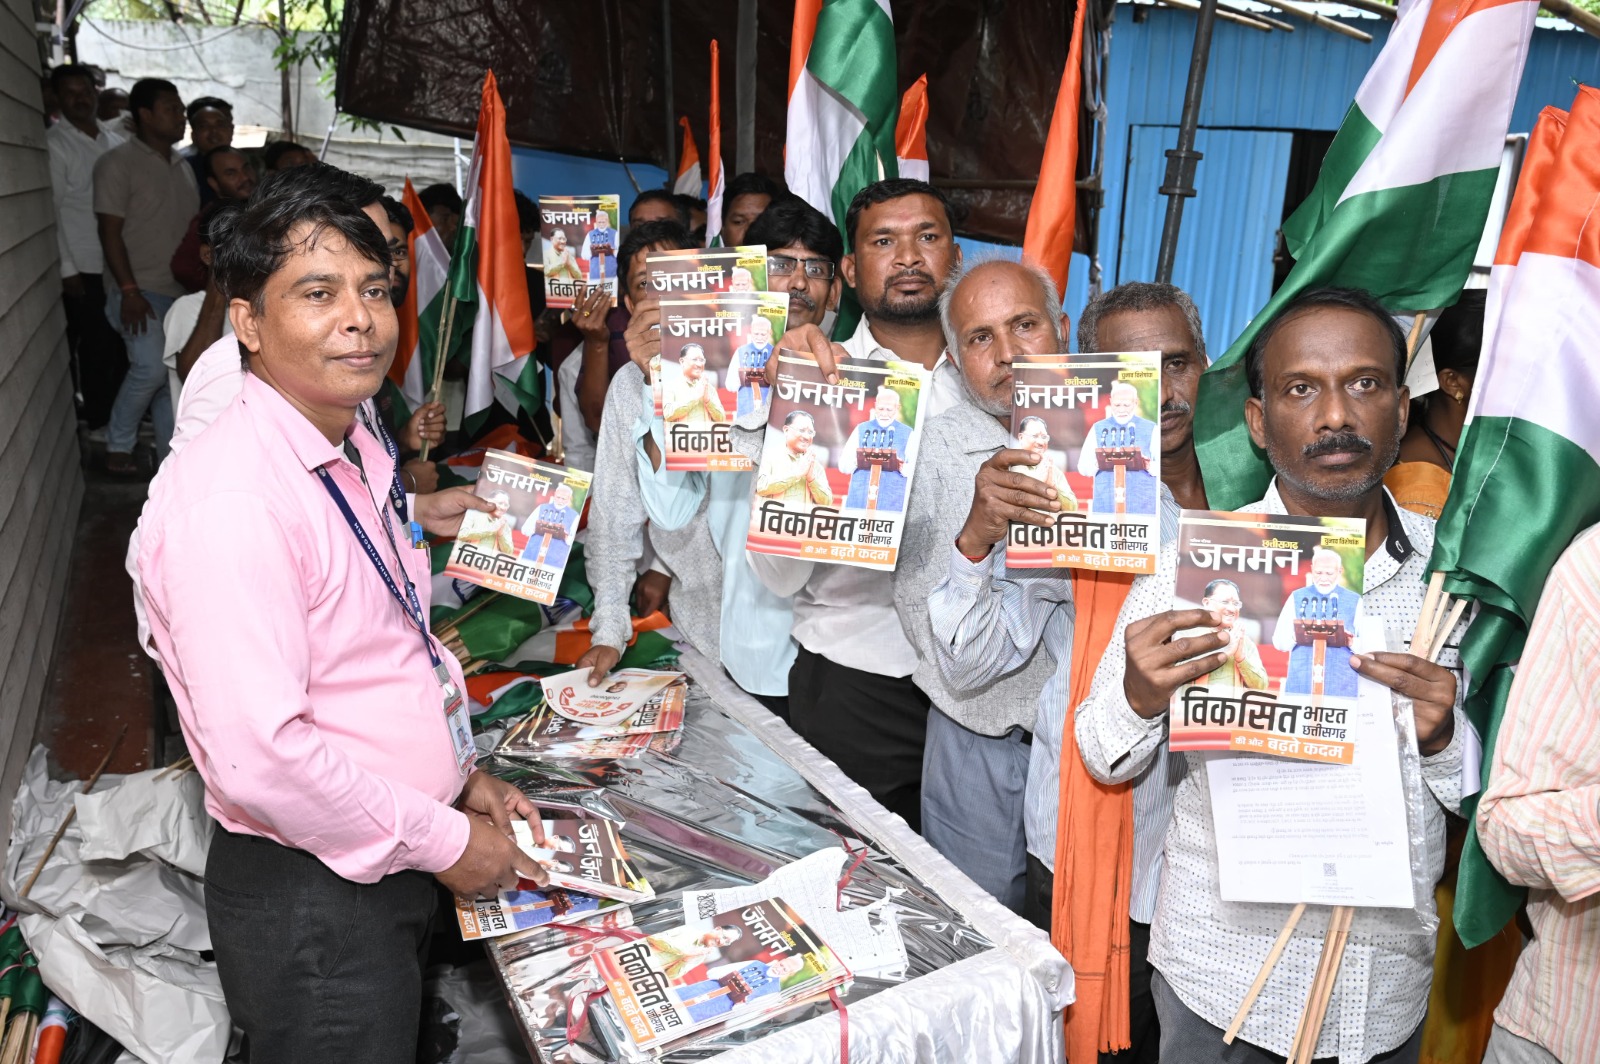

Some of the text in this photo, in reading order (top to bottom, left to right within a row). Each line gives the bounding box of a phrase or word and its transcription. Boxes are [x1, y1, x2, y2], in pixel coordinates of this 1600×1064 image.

[542, 211, 592, 225] जनमन
[652, 270, 725, 291] जनमन
[668, 317, 744, 337] जनमन
[777, 377, 869, 411] जनमन
[1015, 385, 1102, 409] जनमन
[670, 423, 733, 453] विकसि
[486, 467, 552, 496] जनमन
[759, 500, 894, 541] विकसित भारत
[1110, 523, 1148, 538] भारत
[858, 533, 892, 547] छत्तीसगढ़
[1110, 539, 1148, 553] छत्तीसगढ़
[1262, 537, 1299, 549] छत्तीसगढ़
[456, 544, 555, 582] विकसित भारत
[830, 544, 856, 560] बढ़ते
[858, 548, 890, 560] कदम
[1083, 552, 1111, 568] बढ़ते
[1112, 556, 1148, 568] कदम
[1189, 542, 1303, 575] जनमन
[1181, 686, 1348, 734] विकसित भारत
[1302, 724, 1347, 741] छत्तीसगढ़
[1235, 736, 1344, 759] की ओर बढ़ते कदम
[579, 824, 603, 857] जन
[462, 910, 477, 933] कदम
[490, 904, 507, 929] भारत
[741, 906, 793, 957] जनमन
[614, 943, 683, 1028] विकसित भारत
